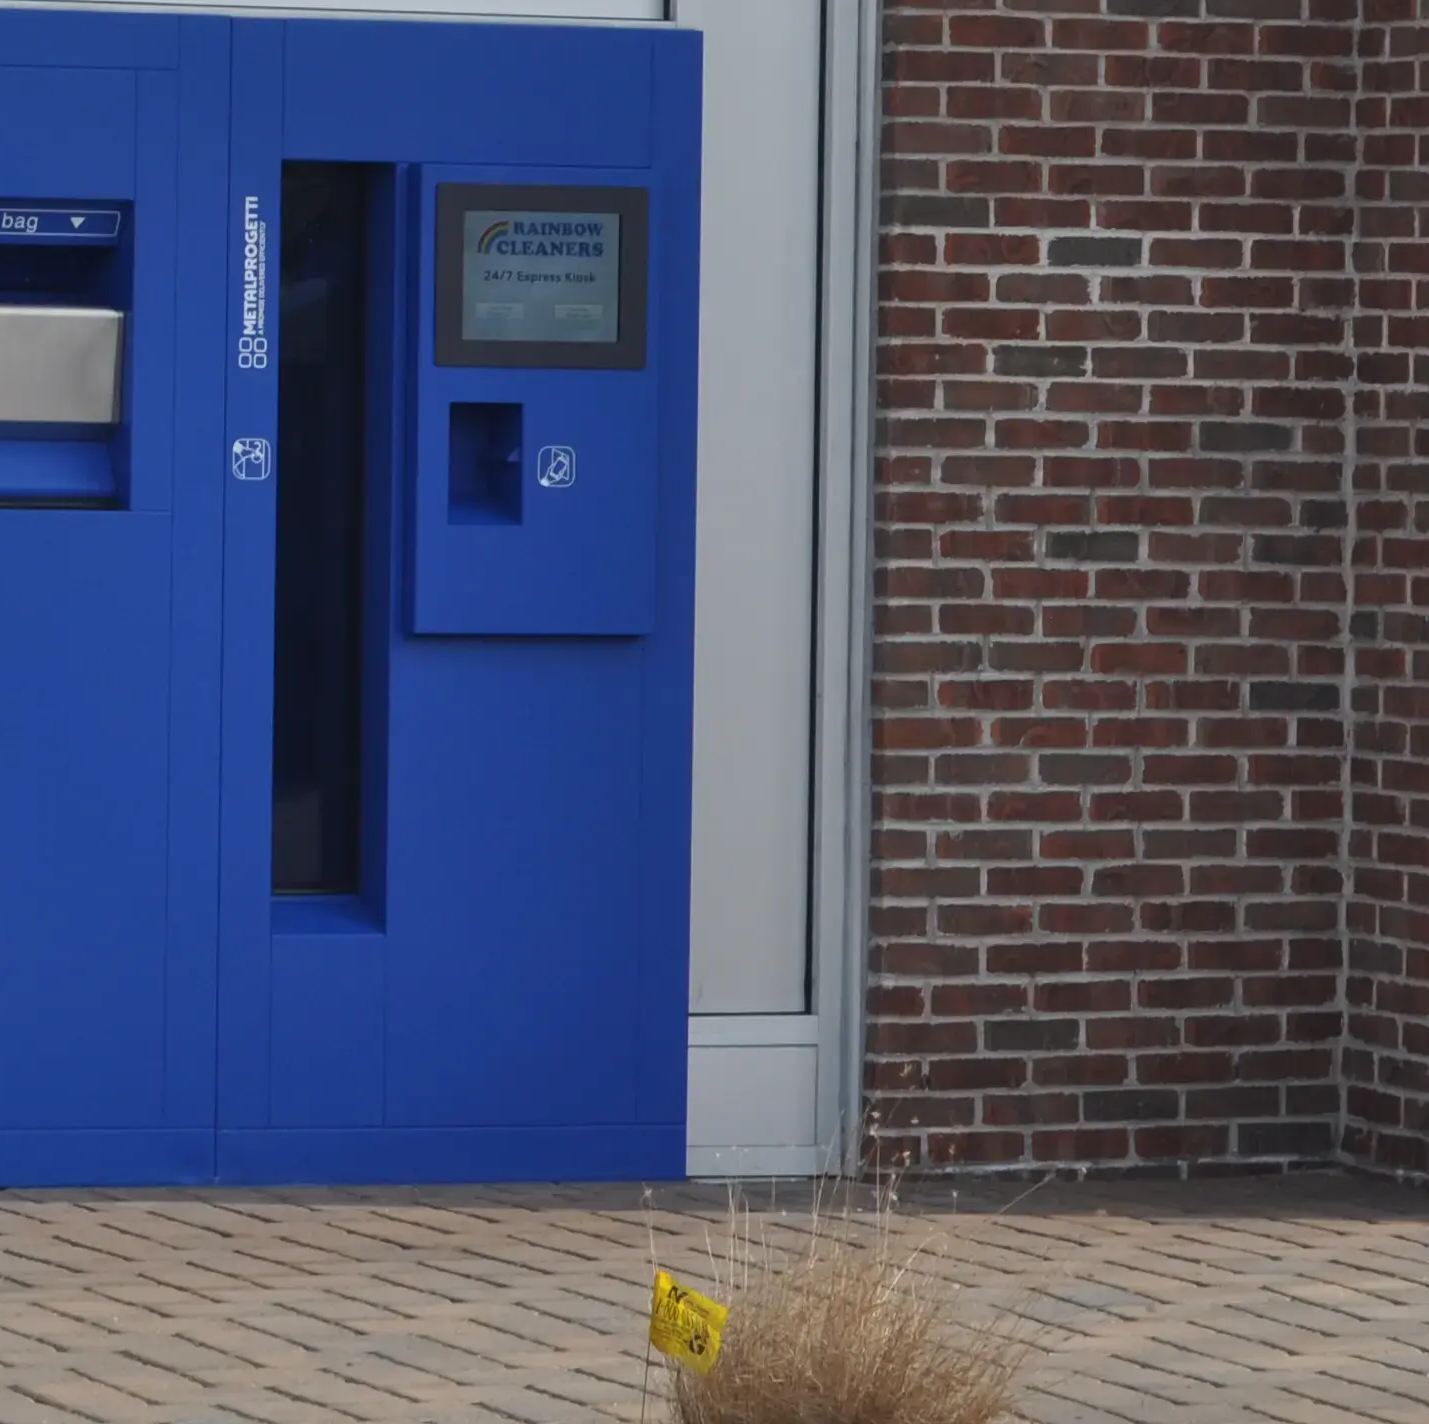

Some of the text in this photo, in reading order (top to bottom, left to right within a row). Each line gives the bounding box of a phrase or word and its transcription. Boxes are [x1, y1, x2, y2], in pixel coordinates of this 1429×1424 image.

[0, 212, 40, 233] bag
[513, 220, 603, 237] RAINBOW
[496, 240, 604, 258] CLEANERS
[243, 195, 259, 336] METALPROGETTI
[483, 270, 513, 282] 24/7
